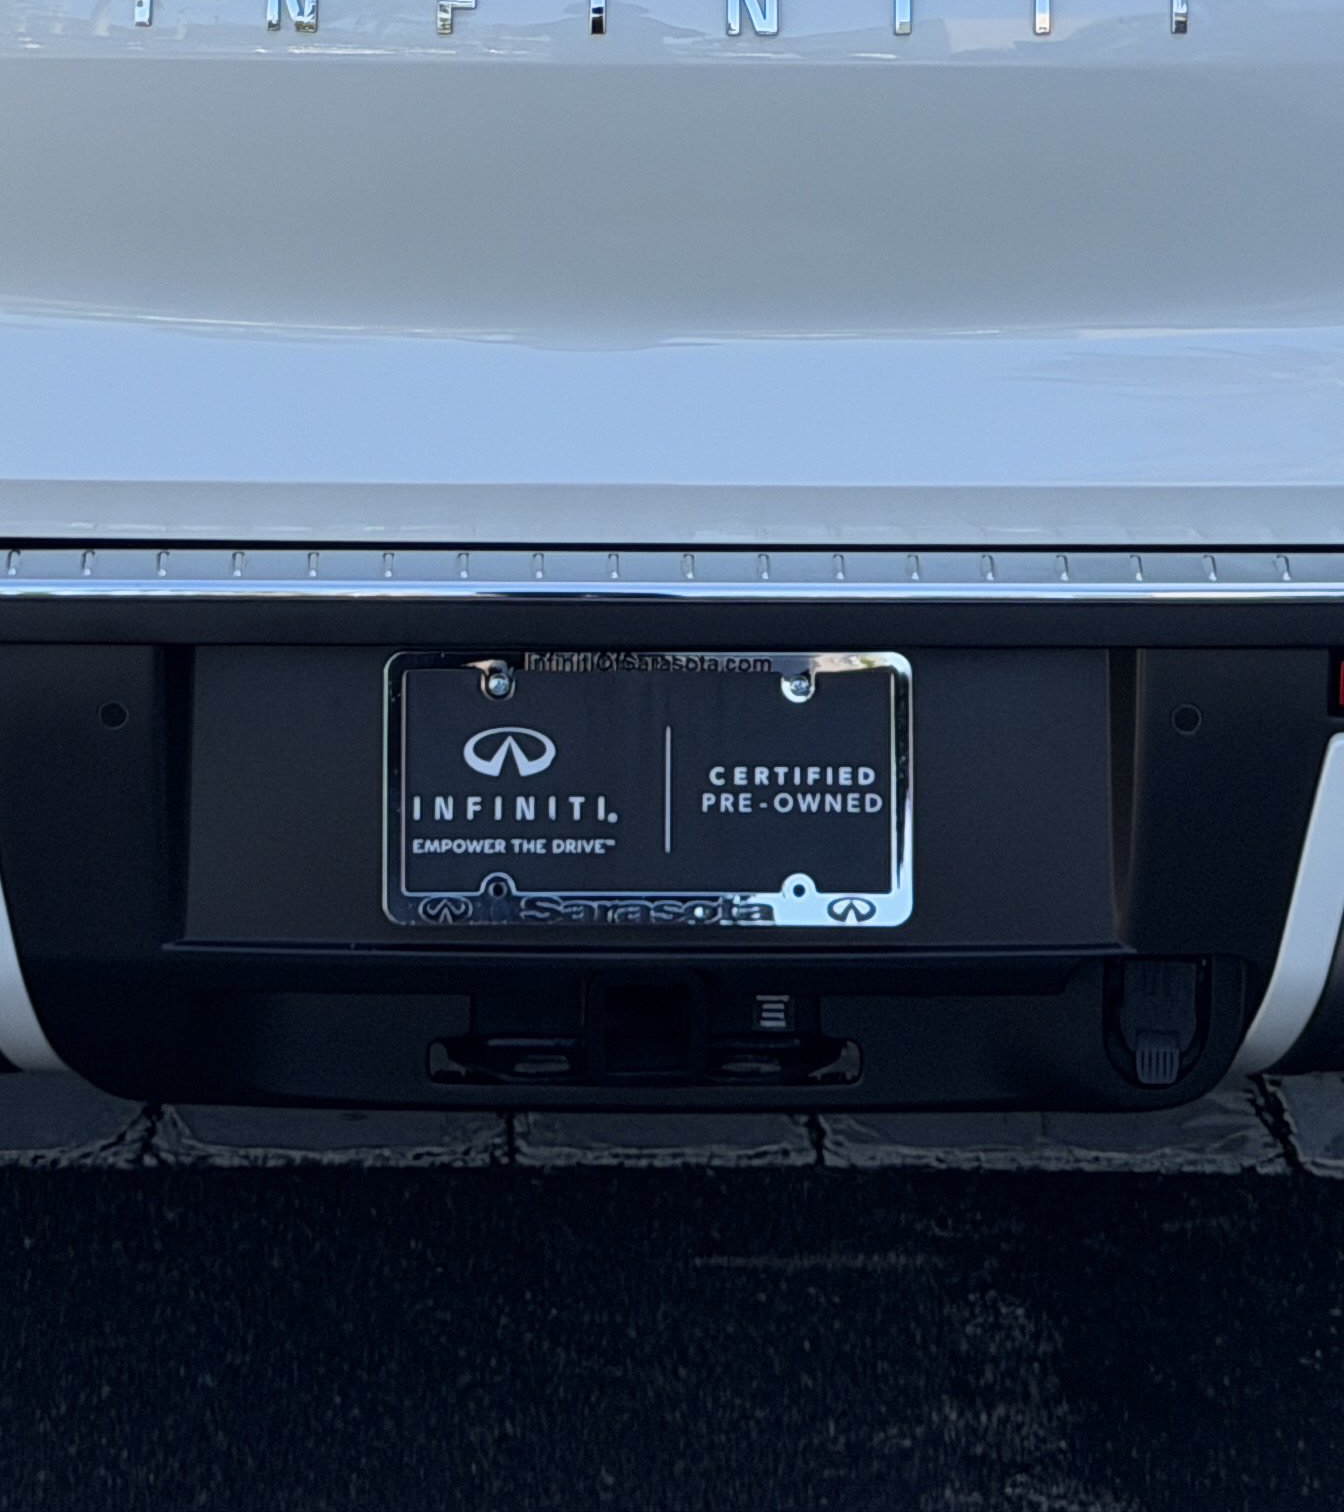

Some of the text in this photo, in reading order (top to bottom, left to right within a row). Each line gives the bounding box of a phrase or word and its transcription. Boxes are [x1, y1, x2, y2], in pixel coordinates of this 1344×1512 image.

[709, 766, 876, 786] CERTIFIED
[701, 792, 883, 813] PRE-OWNED
[412, 839, 506, 854] EMPOWER
[511, 839, 546, 854] THE
[520, 895, 776, 926] Sarasota
